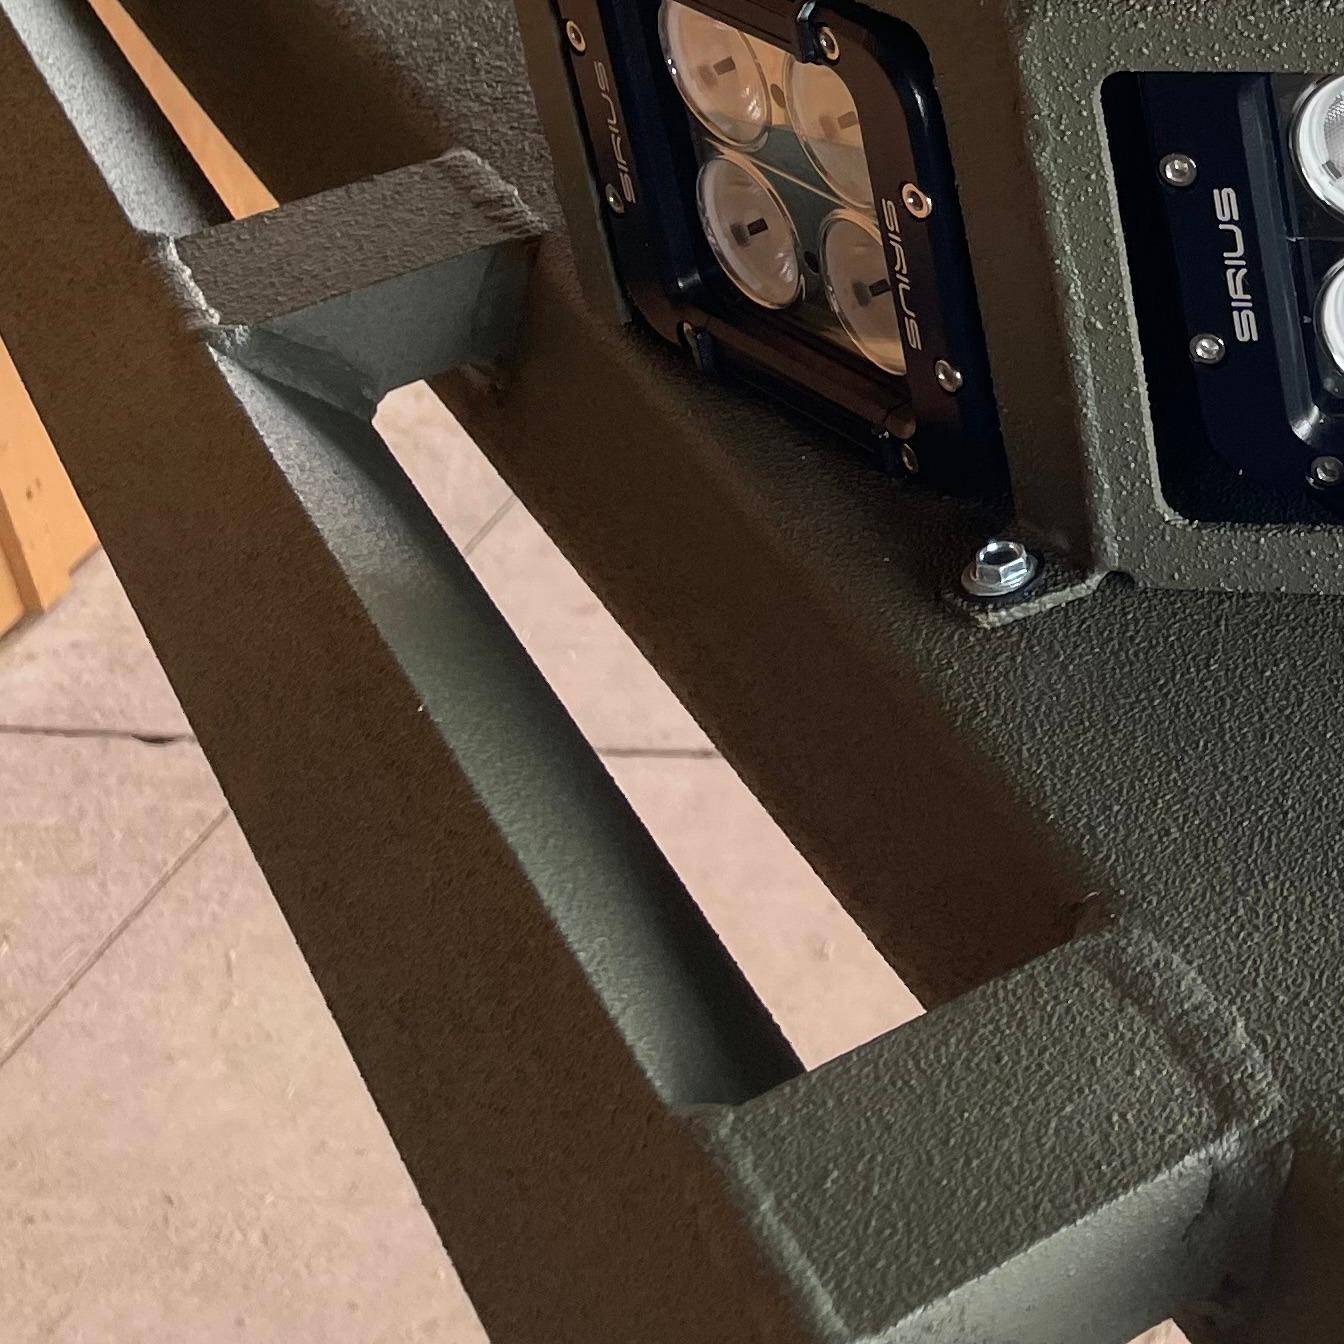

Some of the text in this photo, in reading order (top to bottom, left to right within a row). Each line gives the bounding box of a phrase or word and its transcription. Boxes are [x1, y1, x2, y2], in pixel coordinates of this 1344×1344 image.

[593, 60, 637, 204] SIRIUS
[882, 198, 922, 351] SIRIUS
[1213, 187, 1258, 342] SIRIUS
